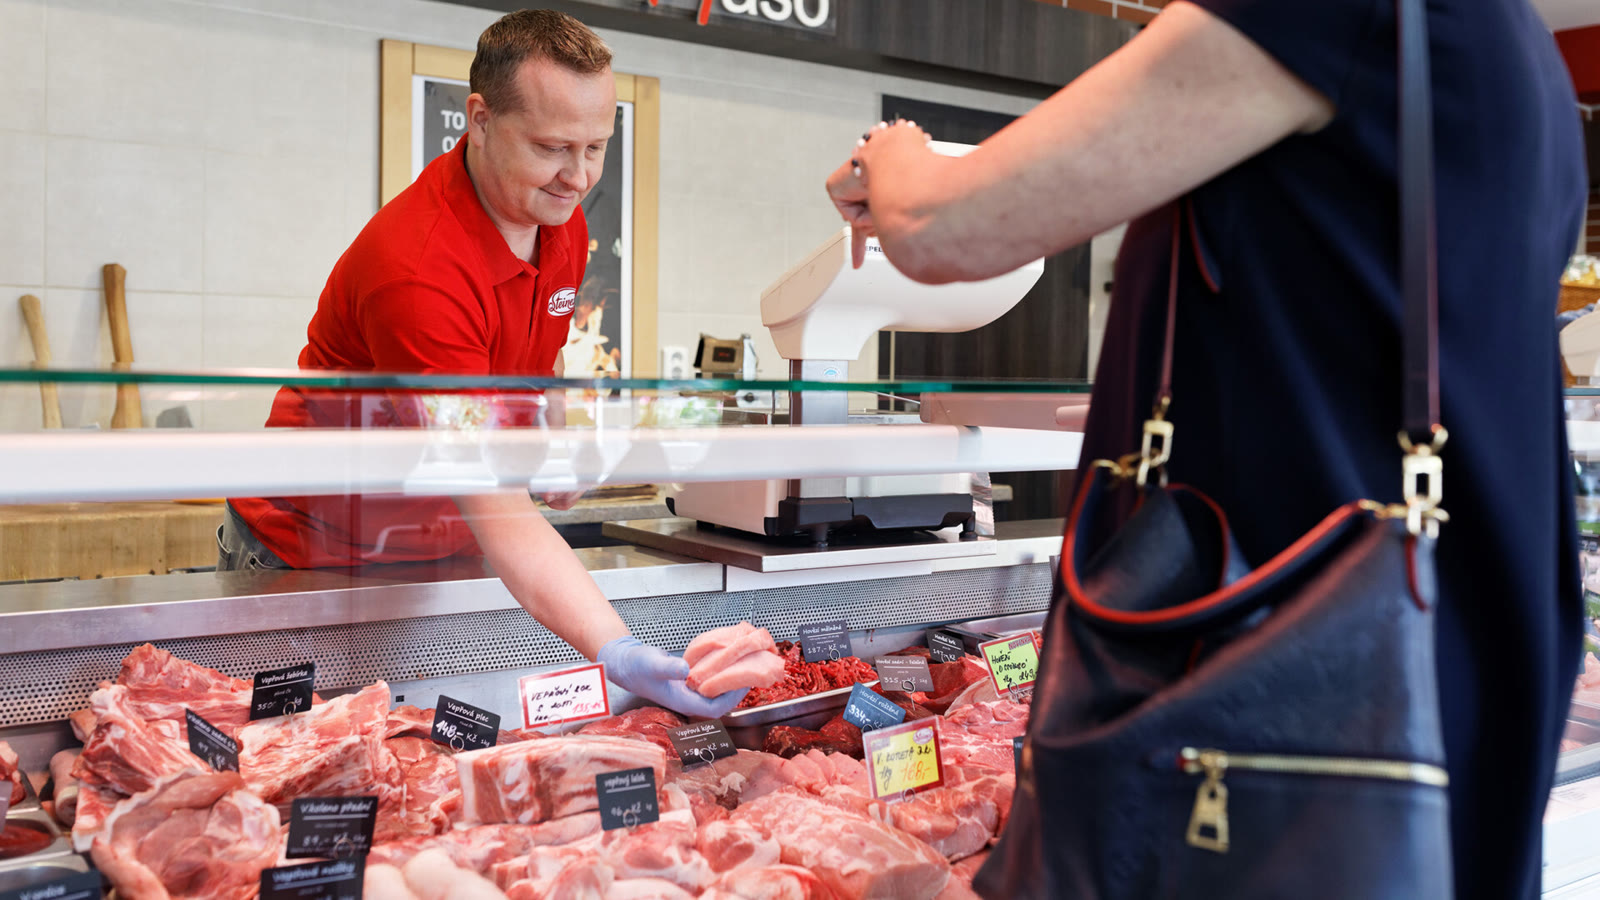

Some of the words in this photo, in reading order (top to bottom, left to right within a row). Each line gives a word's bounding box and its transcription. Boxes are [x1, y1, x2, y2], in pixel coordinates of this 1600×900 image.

[442, 136, 462, 153] O
[549, 292, 576, 312] Steine
[447, 701, 475, 717] Vepřová
